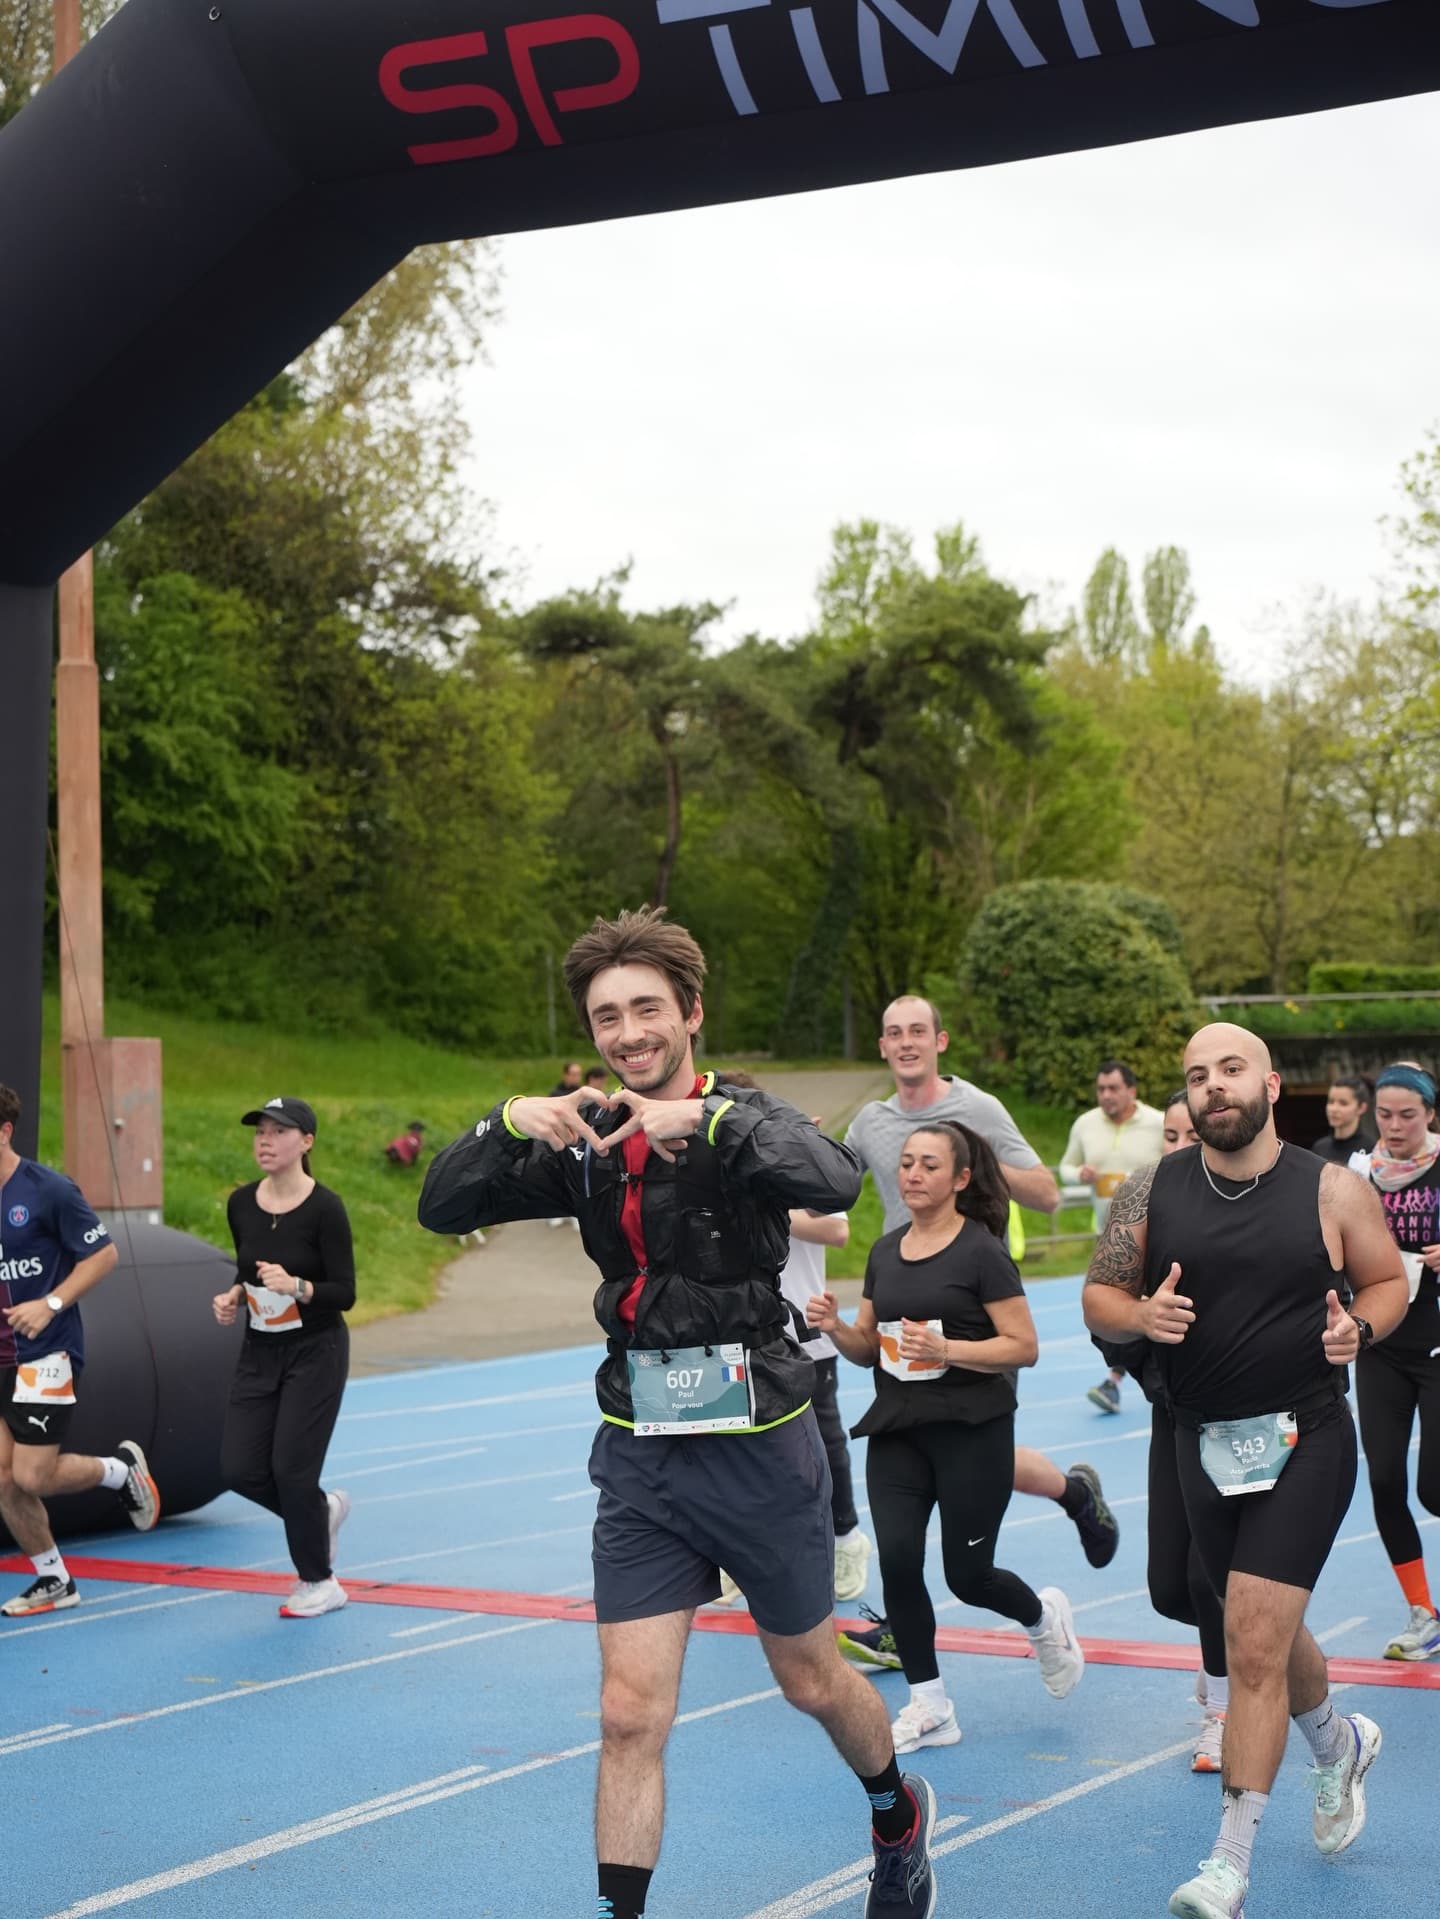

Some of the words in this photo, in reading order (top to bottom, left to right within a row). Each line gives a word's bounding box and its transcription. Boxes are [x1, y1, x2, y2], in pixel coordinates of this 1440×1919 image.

[378, 13, 641, 166] SP
[655, 0, 1395, 116] TIMIN
[666, 1368, 704, 1389] 607
[678, 1390, 694, 1398] Paul
[1231, 1436, 1266, 1457] 543
